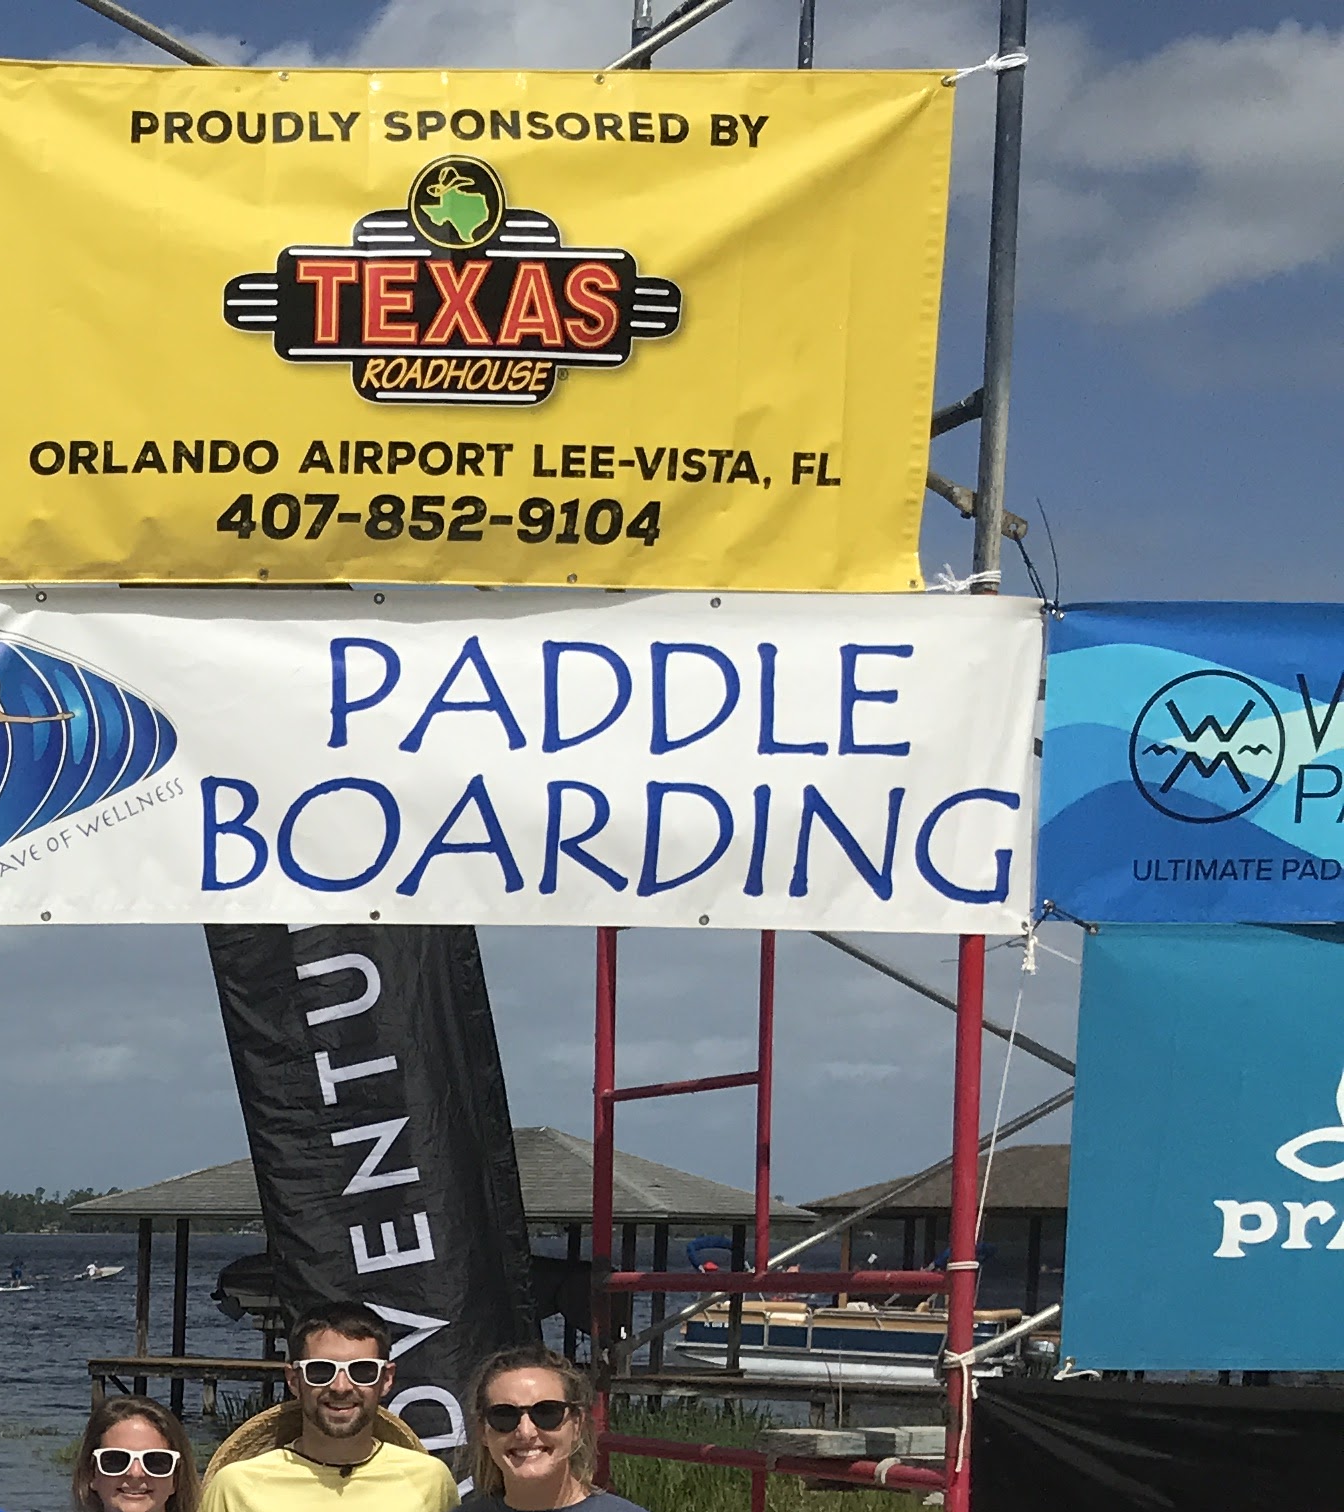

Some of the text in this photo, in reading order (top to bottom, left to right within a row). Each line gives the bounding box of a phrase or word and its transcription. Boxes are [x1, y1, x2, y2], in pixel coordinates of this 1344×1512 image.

[130, 108, 770, 149] PROUDLY SPONSORED BY
[296, 258, 622, 350] TEXAS
[360, 357, 553, 392] ROADHOUSE
[29, 440, 841, 490] ORLANDO AIRPORT LEE-VISTA, FL
[217, 493, 662, 546] 407-852-9104
[326, 636, 914, 758] PADDLE
[46, 829, 72, 852] OF
[76, 777, 184, 838] WELLNESS
[201, 774, 1026, 904] BOARDING
[1132, 858, 1274, 882] ULTIMATE
